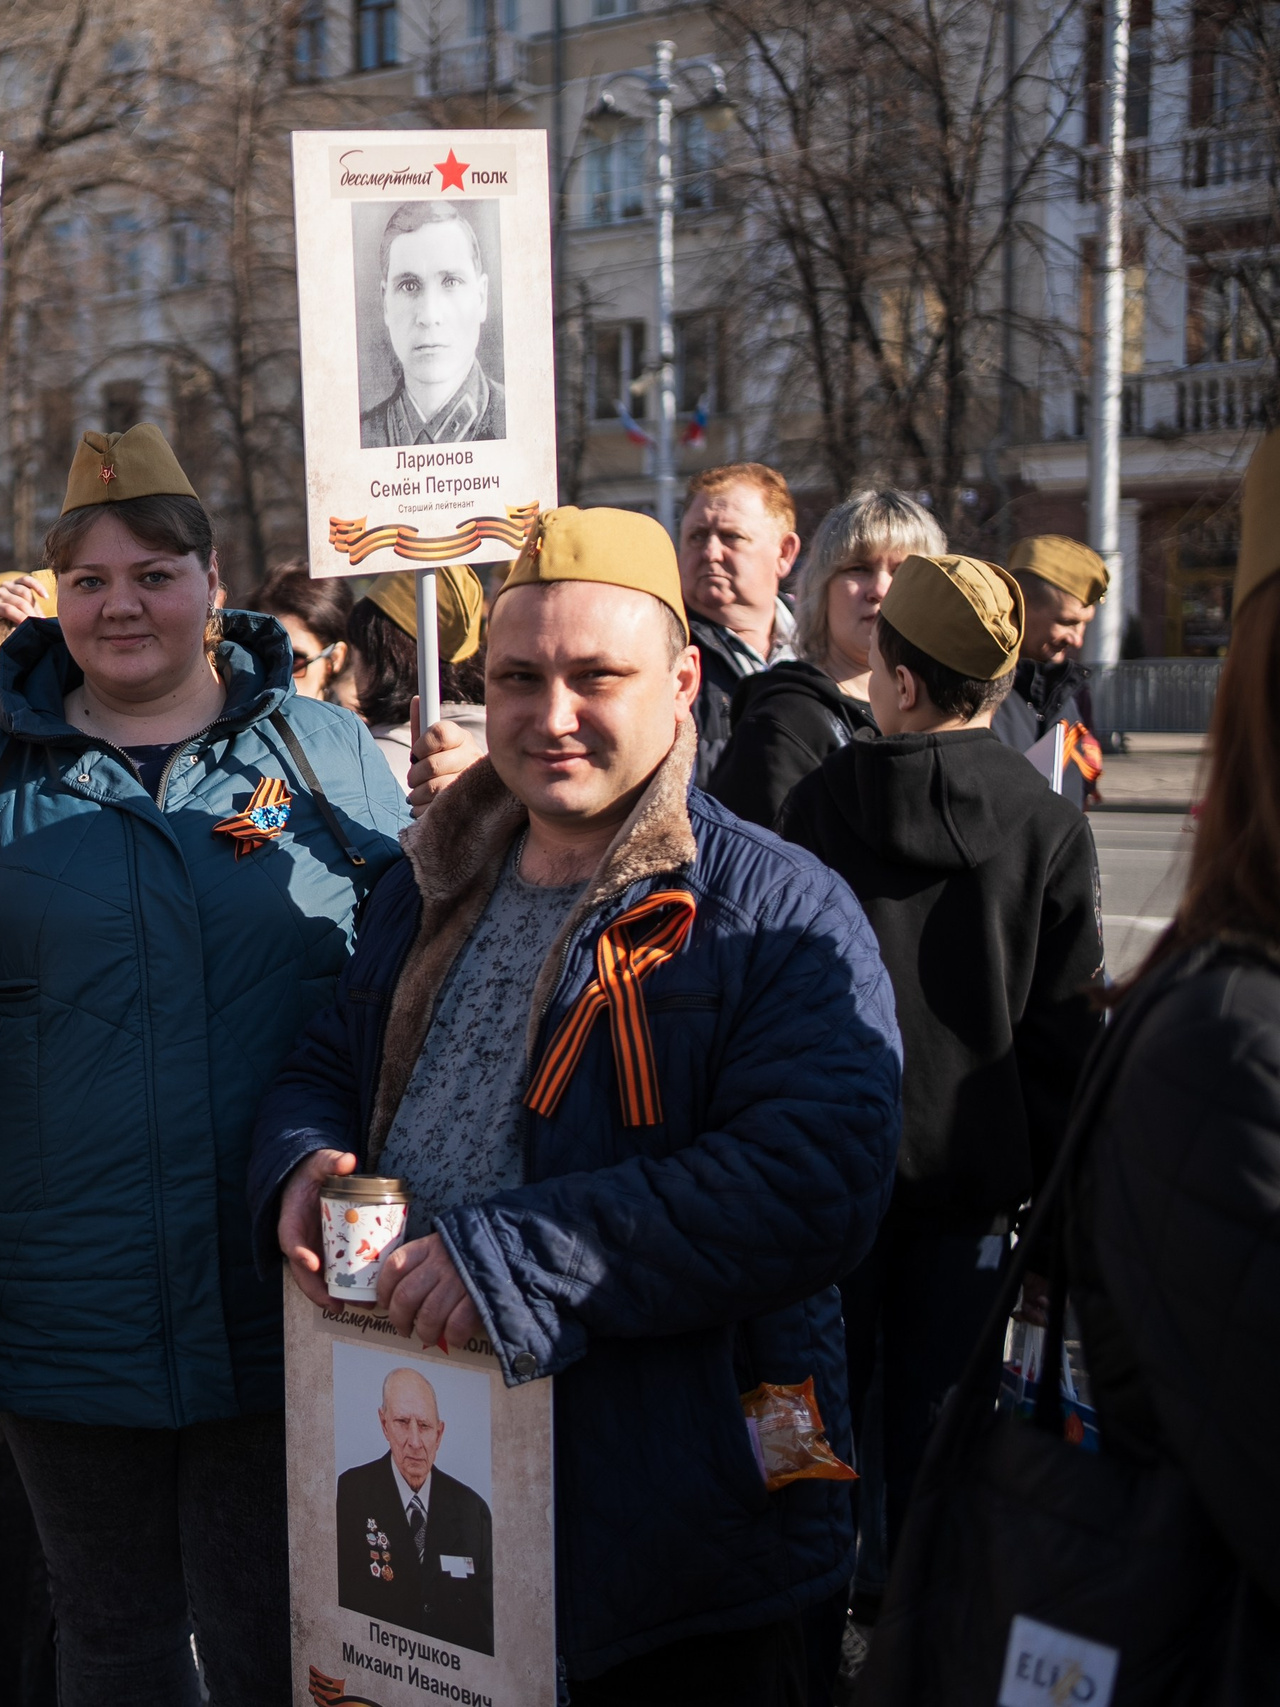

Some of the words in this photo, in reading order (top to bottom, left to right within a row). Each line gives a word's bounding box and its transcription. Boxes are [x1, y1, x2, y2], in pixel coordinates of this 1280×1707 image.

[339, 149, 434, 190] бессмертный
[395, 450, 474, 472] Ларионов
[370, 477, 421, 498] Семён
[426, 475, 500, 496] Петрович
[397, 503, 433, 515] Старший
[435, 499, 475, 511] лейтенант
[369, 1621, 461, 1672] Петрушков
[342, 1642, 403, 1683] Михаил
[408, 1666, 493, 1707] Иванович
